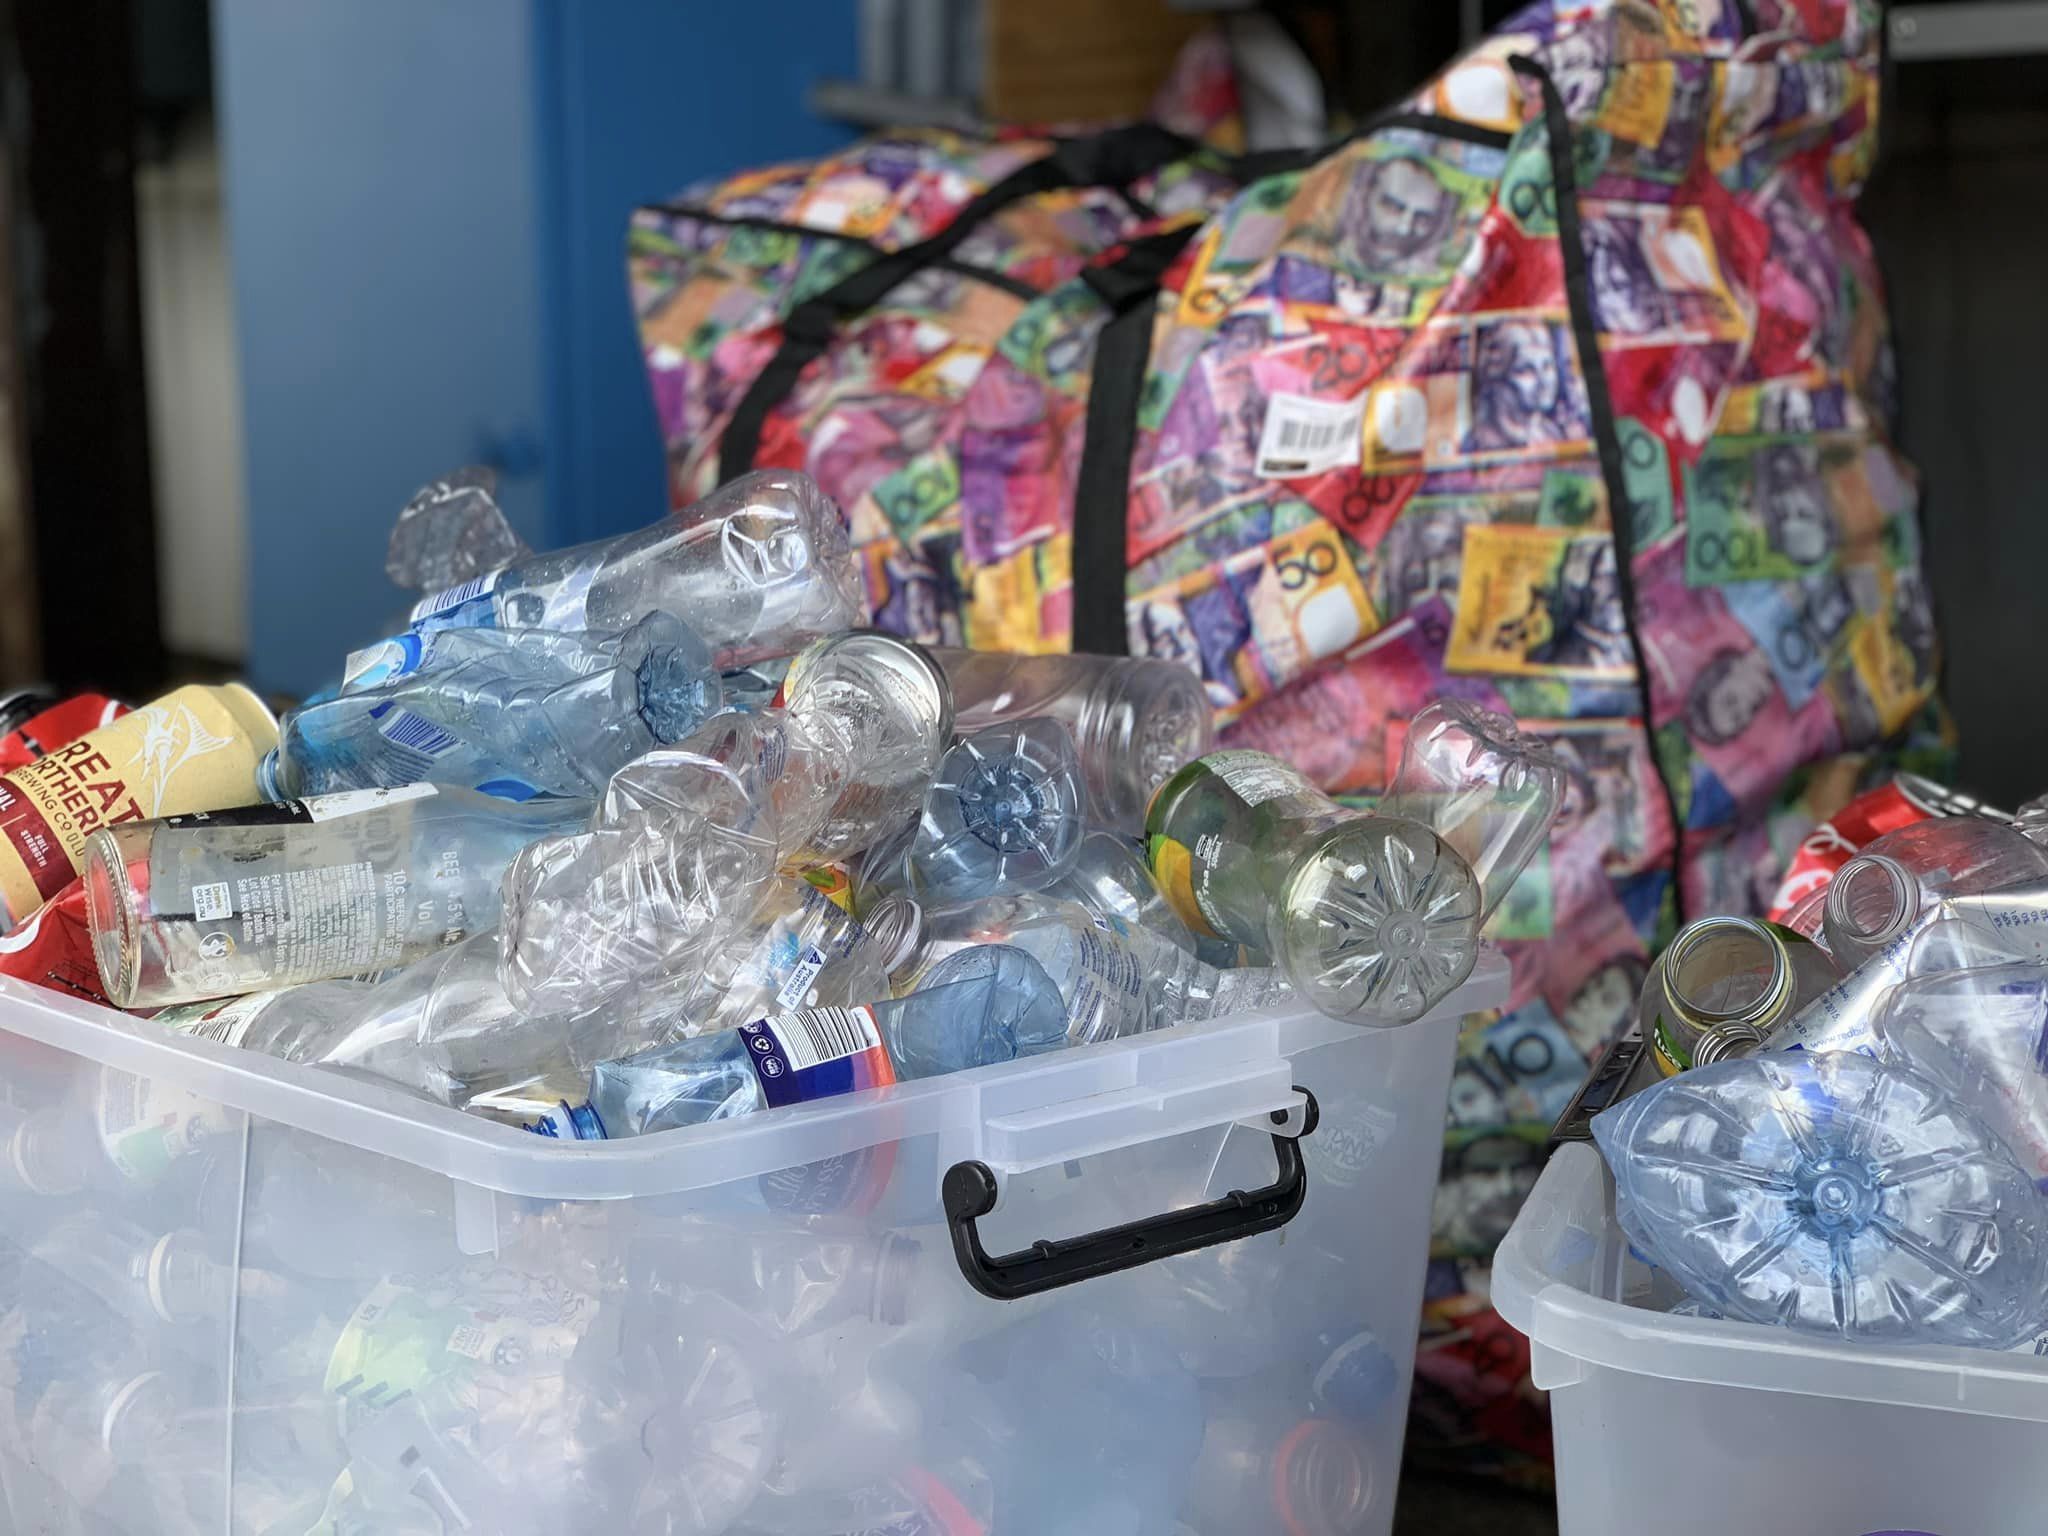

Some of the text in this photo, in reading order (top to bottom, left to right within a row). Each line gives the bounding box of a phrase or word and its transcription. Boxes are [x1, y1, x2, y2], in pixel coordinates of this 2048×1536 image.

[1272, 540, 1338, 590] 50
[54, 740, 145, 826] REAT
[20, 829, 48, 868] STRENGTH
[34, 834, 49, 854] FULL
[237, 879, 248, 892] See
[248, 877, 259, 890] Lot
[260, 875, 270, 889] See
[196, 888, 206, 918] org.au
[212, 886, 221, 908] Drink
[418, 900, 434, 930] Vol.
[784, 964, 807, 996] Australia
[793, 968, 814, 996] Product
